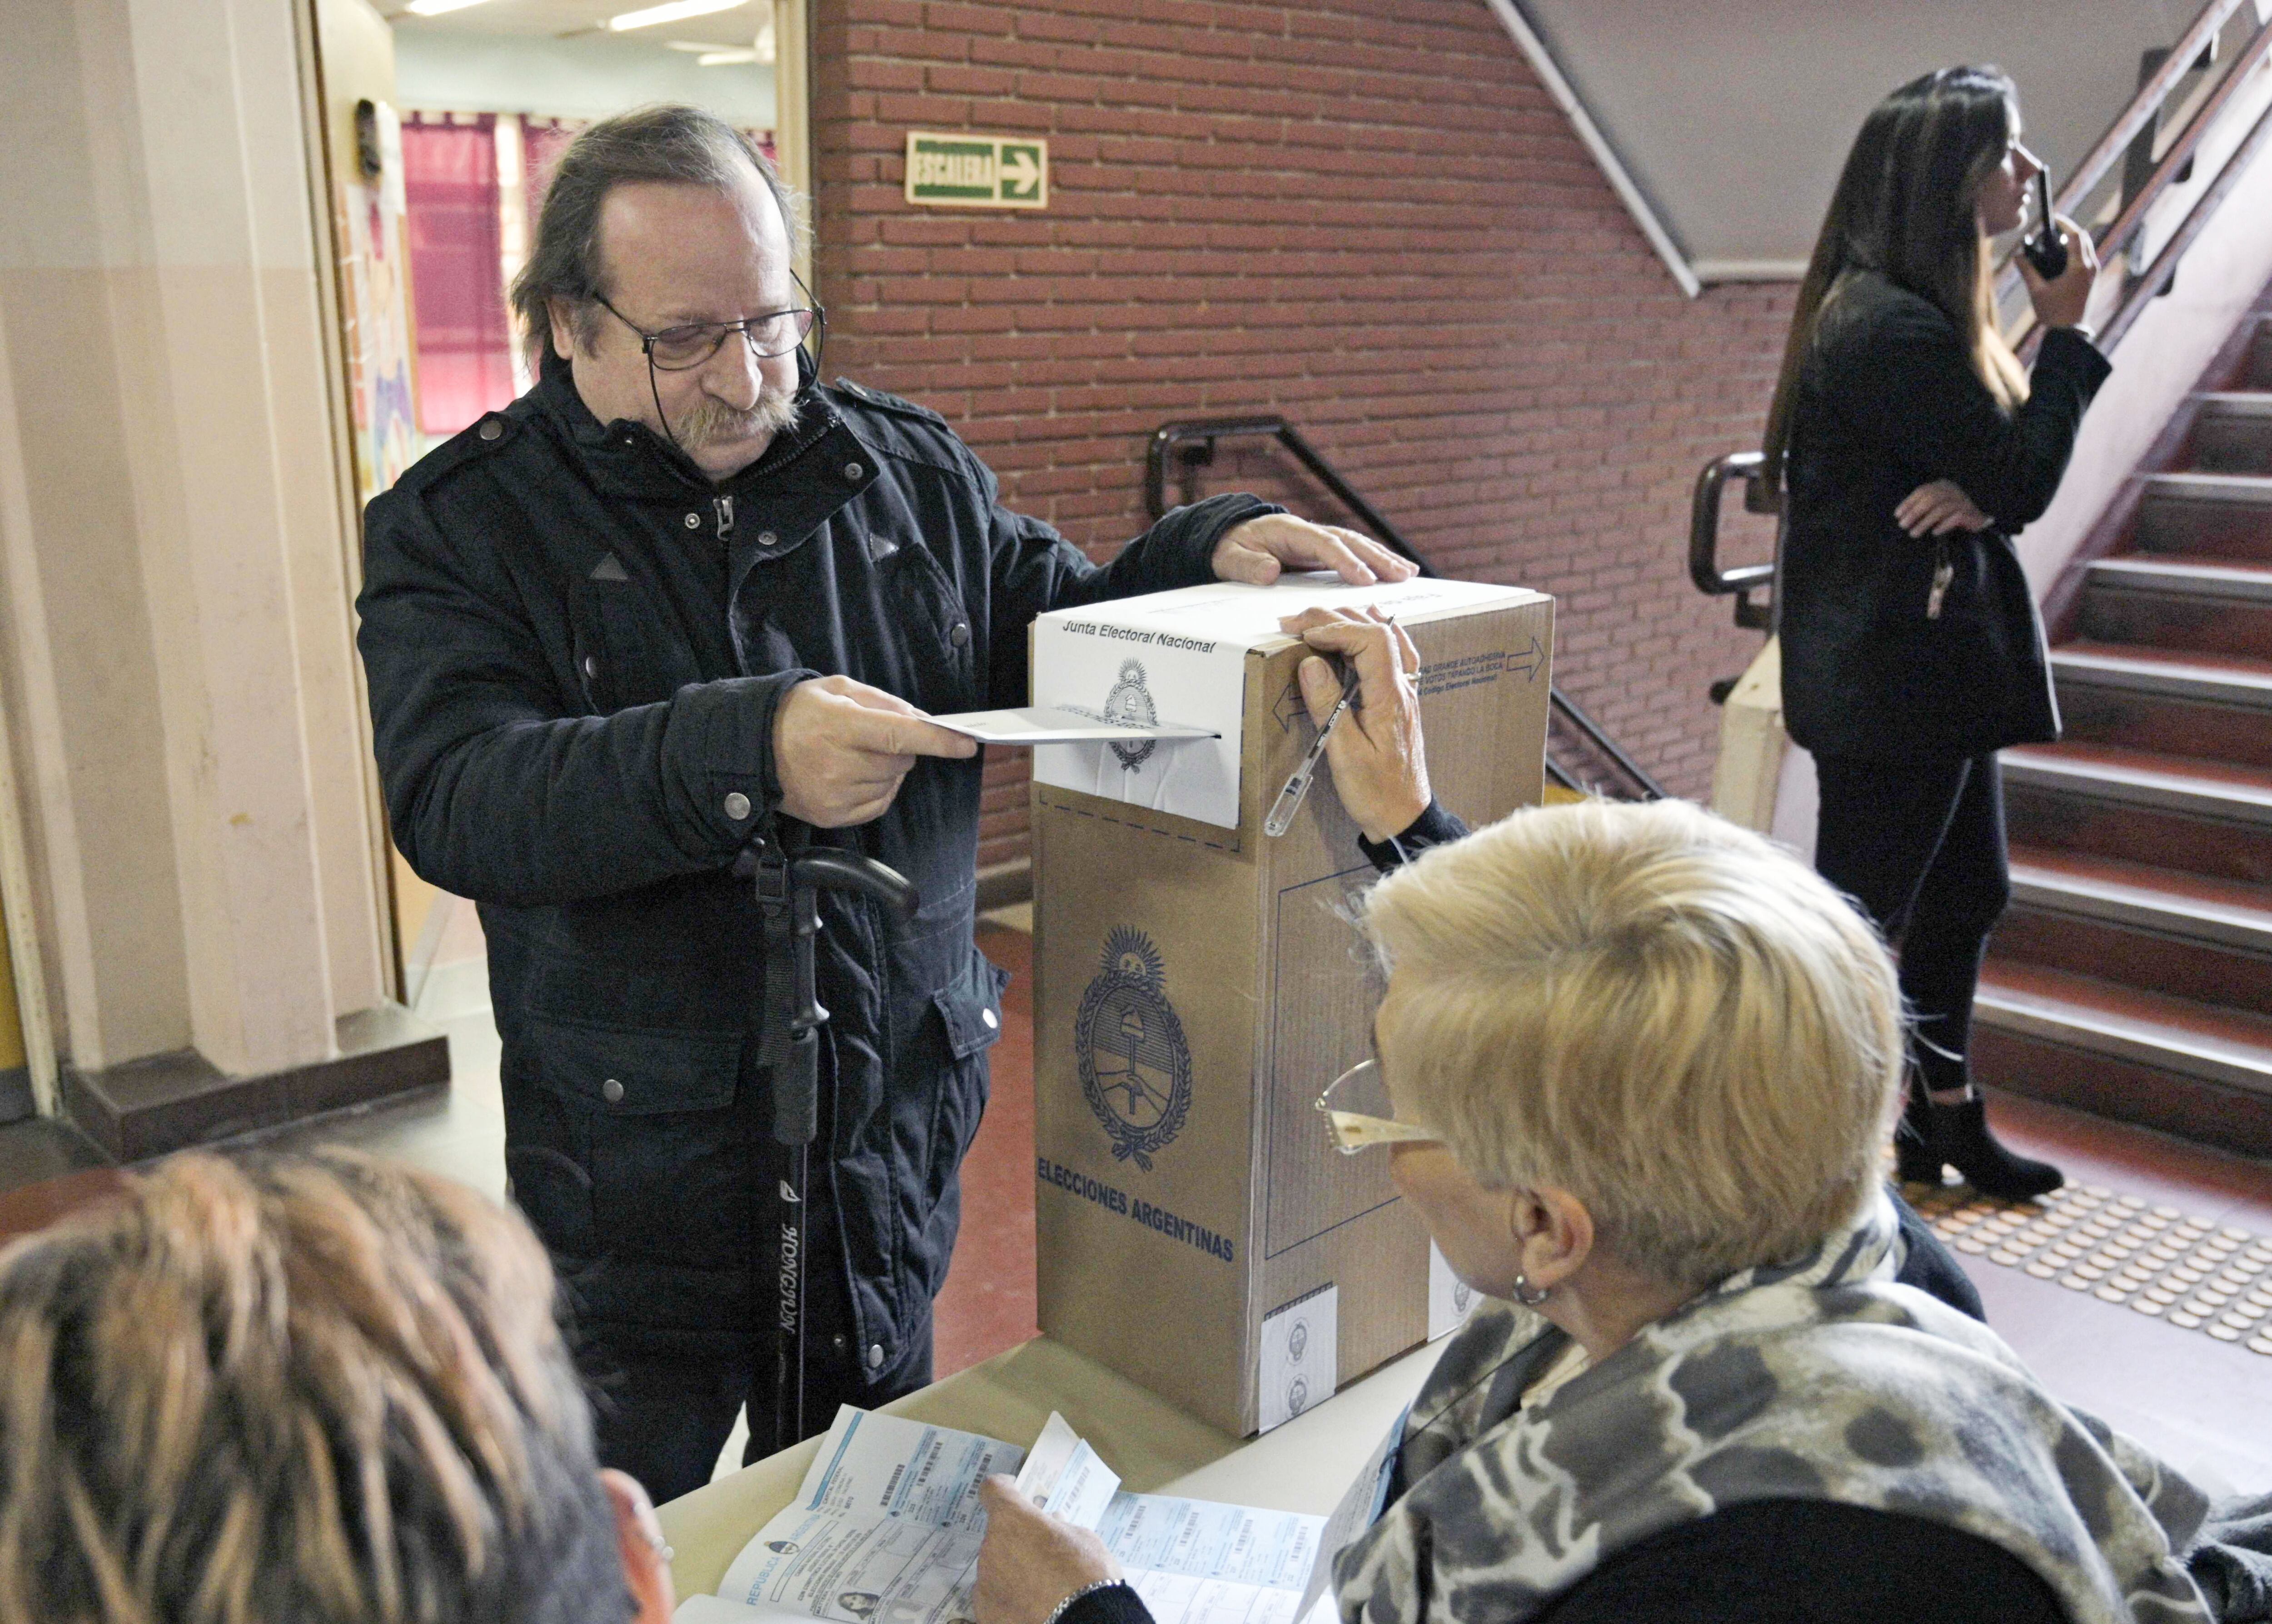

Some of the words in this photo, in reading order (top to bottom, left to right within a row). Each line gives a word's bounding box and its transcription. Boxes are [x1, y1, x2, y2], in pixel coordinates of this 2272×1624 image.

[1062, 620, 1096, 636] Junta
[1100, 624, 1156, 644] Electoral
[1157, 633, 1216, 654] Nacional
[1037, 1157, 1127, 1215] ELECCIONES
[1131, 1198, 1234, 1262] ARGENTINAS
[746, 1555, 781, 1605] REPUBLICA
